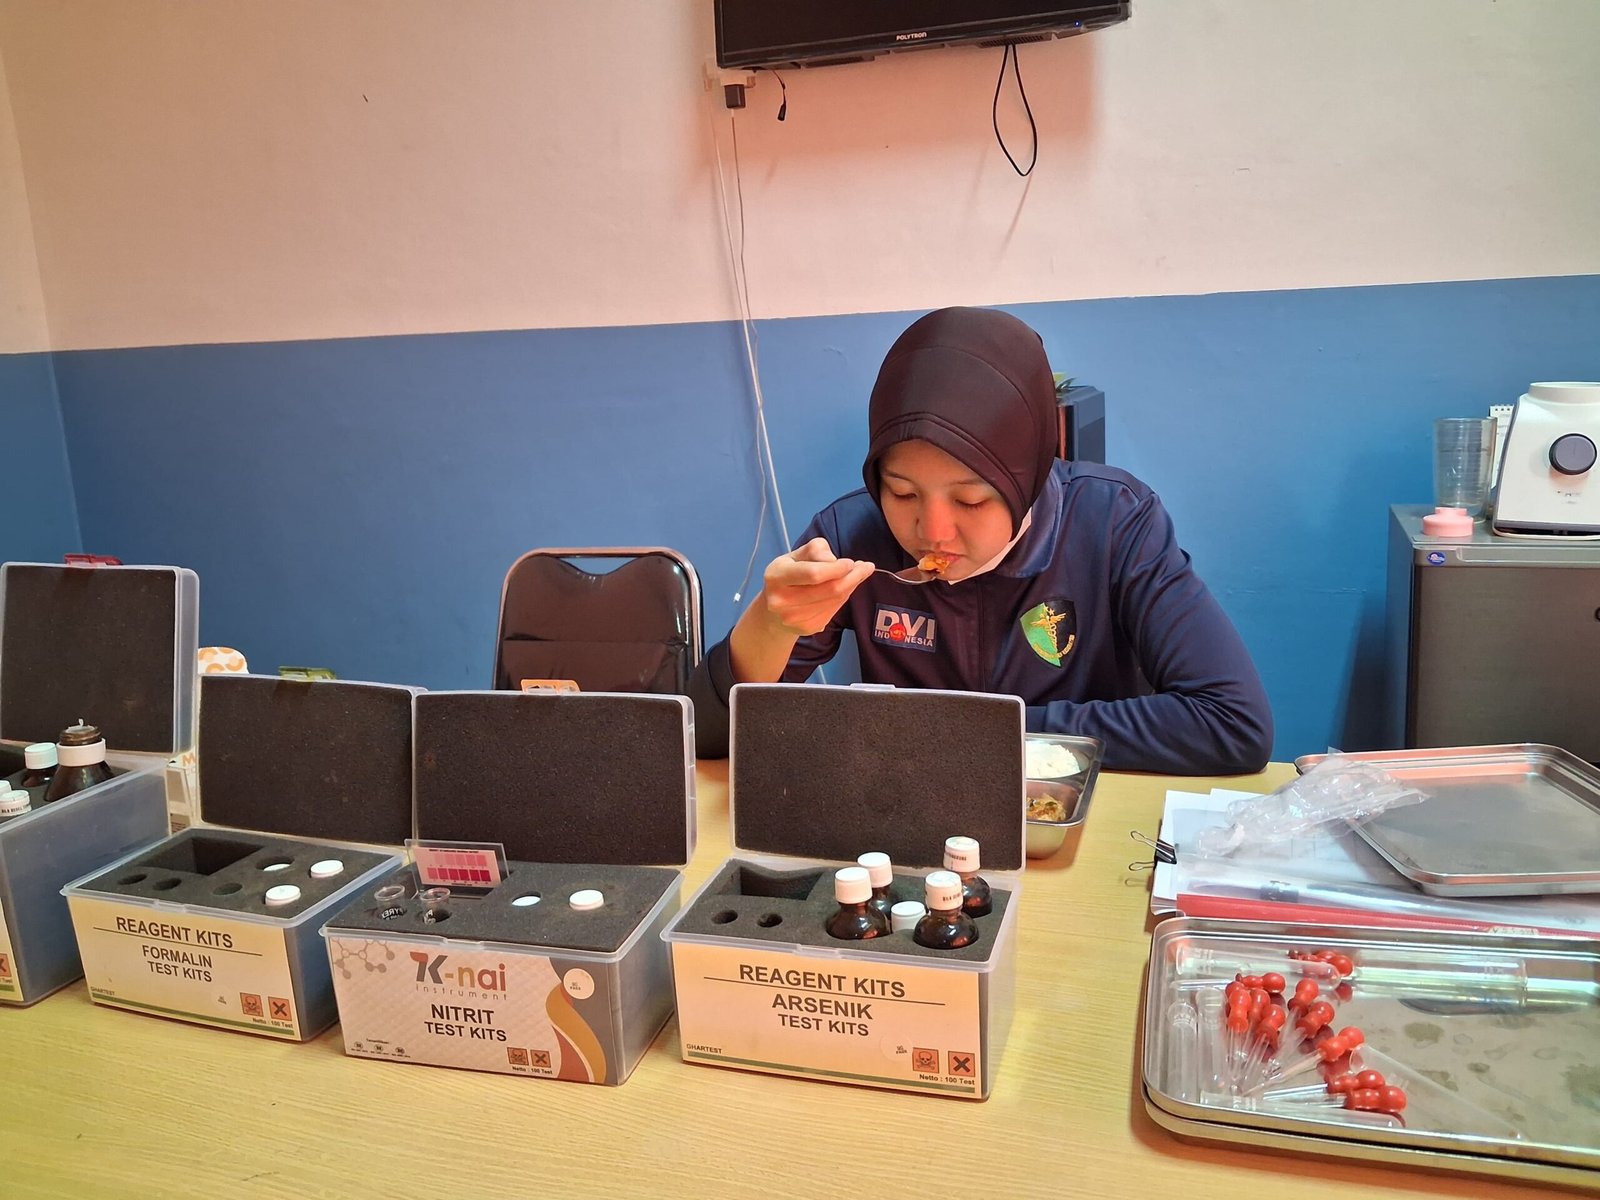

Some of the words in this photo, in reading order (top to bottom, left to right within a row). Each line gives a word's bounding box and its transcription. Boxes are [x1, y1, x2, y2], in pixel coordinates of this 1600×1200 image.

[896, 32, 927, 40] POLYTRON
[876, 609, 935, 640] DVI
[116, 916, 191, 942] REAGENT
[196, 929, 233, 949] KITS
[142, 945, 213, 969] FORMALIN
[147, 961, 179, 977] TEST
[183, 967, 213, 983] KITS
[739, 964, 847, 992] REAGENT
[854, 977, 906, 999] KITS
[431, 1004, 494, 1025] NITRIT
[772, 994, 873, 1020] ARSENIK
[424, 1021, 464, 1037] TEST
[470, 1026, 507, 1042] KITS
[778, 1013, 823, 1031] TEST
[828, 1020, 870, 1037] KITS
[919, 1073, 939, 1082] Netto
[944, 1076, 958, 1084] 100
[959, 1077, 975, 1086] Test
